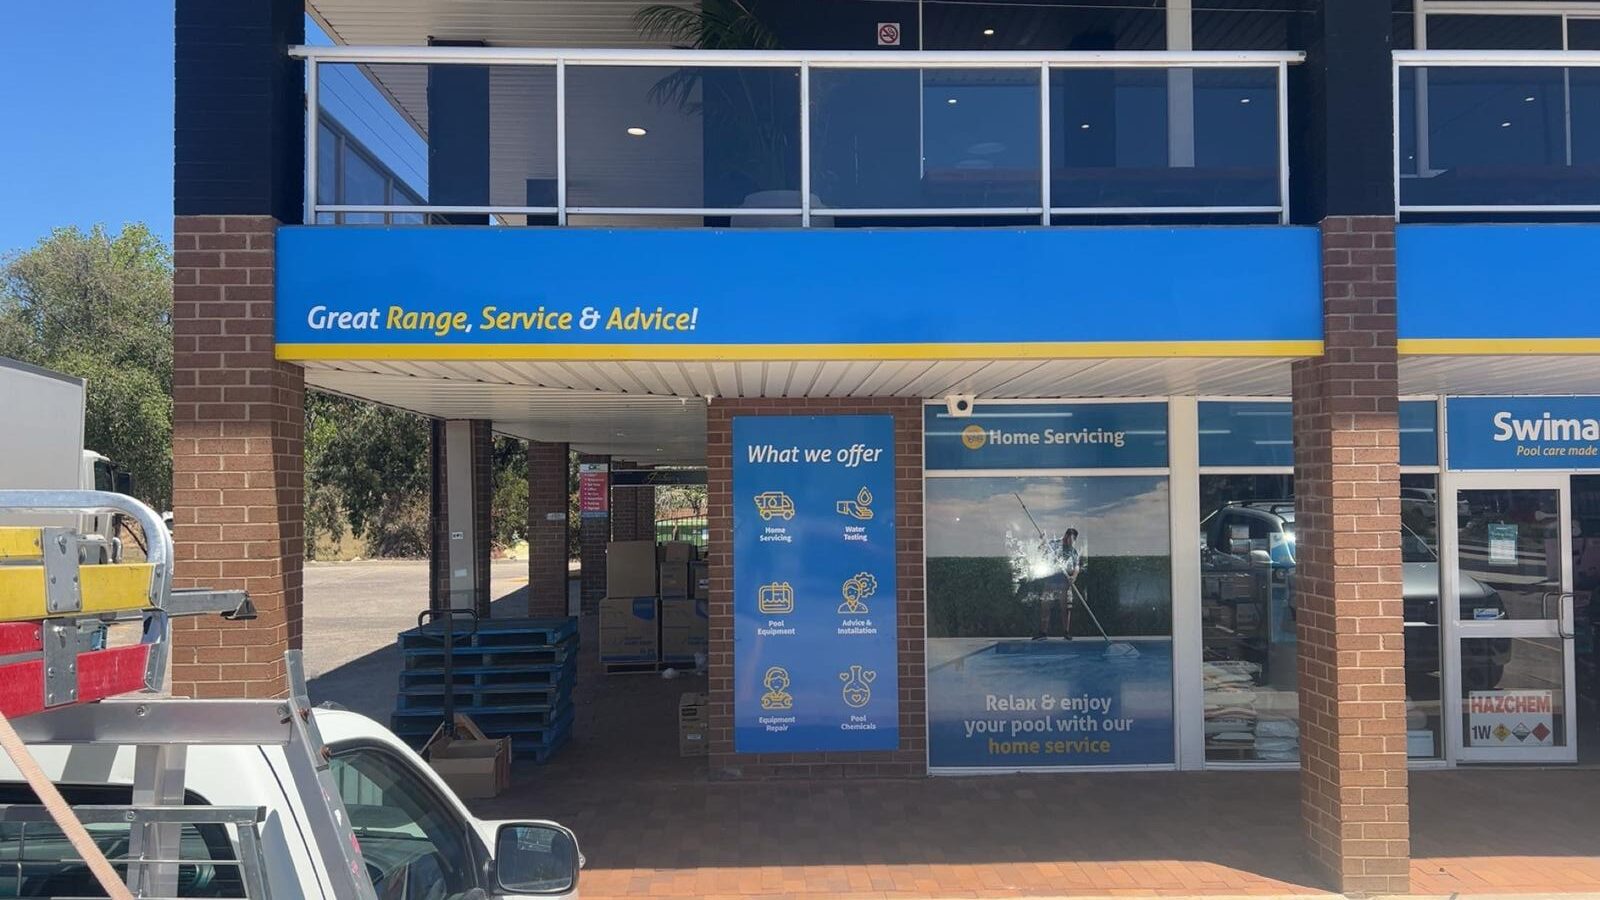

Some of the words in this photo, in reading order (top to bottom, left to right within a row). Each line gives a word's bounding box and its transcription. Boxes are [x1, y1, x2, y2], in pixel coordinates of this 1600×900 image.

[307, 305, 380, 330] Great
[386, 305, 473, 336] Range,
[480, 306, 572, 330] Service
[579, 308, 600, 330] &
[605, 306, 698, 331] Advice!
[1494, 411, 1600, 441] Swima
[989, 429, 1040, 445] Home
[1044, 428, 1125, 447] Servicing
[747, 445, 799, 463] What
[804, 448, 832, 462] we
[837, 444, 883, 467] offer
[1517, 446, 1541, 456] Pool
[1543, 447, 1566, 456] care
[1568, 445, 1597, 456] made
[765, 526, 786, 534] Home
[759, 534, 792, 543] Servicing
[843, 533, 868, 542] Testing
[842, 619, 865, 627] Advice
[757, 627, 796, 636] Equipment
[837, 626, 877, 635] Installation
[986, 694, 1037, 711] Relax
[1041, 694, 1056, 711] &
[1060, 693, 1112, 714] enjoy
[1472, 695, 1551, 714] HAZCHEM
[759, 716, 796, 725] Equipment
[850, 714, 867, 722] Pool
[765, 724, 789, 733] Repair
[841, 722, 877, 731] Chemicals
[964, 718, 1007, 738] your
[1011, 716, 1053, 736] pool
[1056, 714, 1098, 732] with
[1102, 718, 1134, 732] our
[1471, 724, 1492, 741] 1W
[988, 737, 1040, 754] home
[1045, 736, 1111, 753] service
